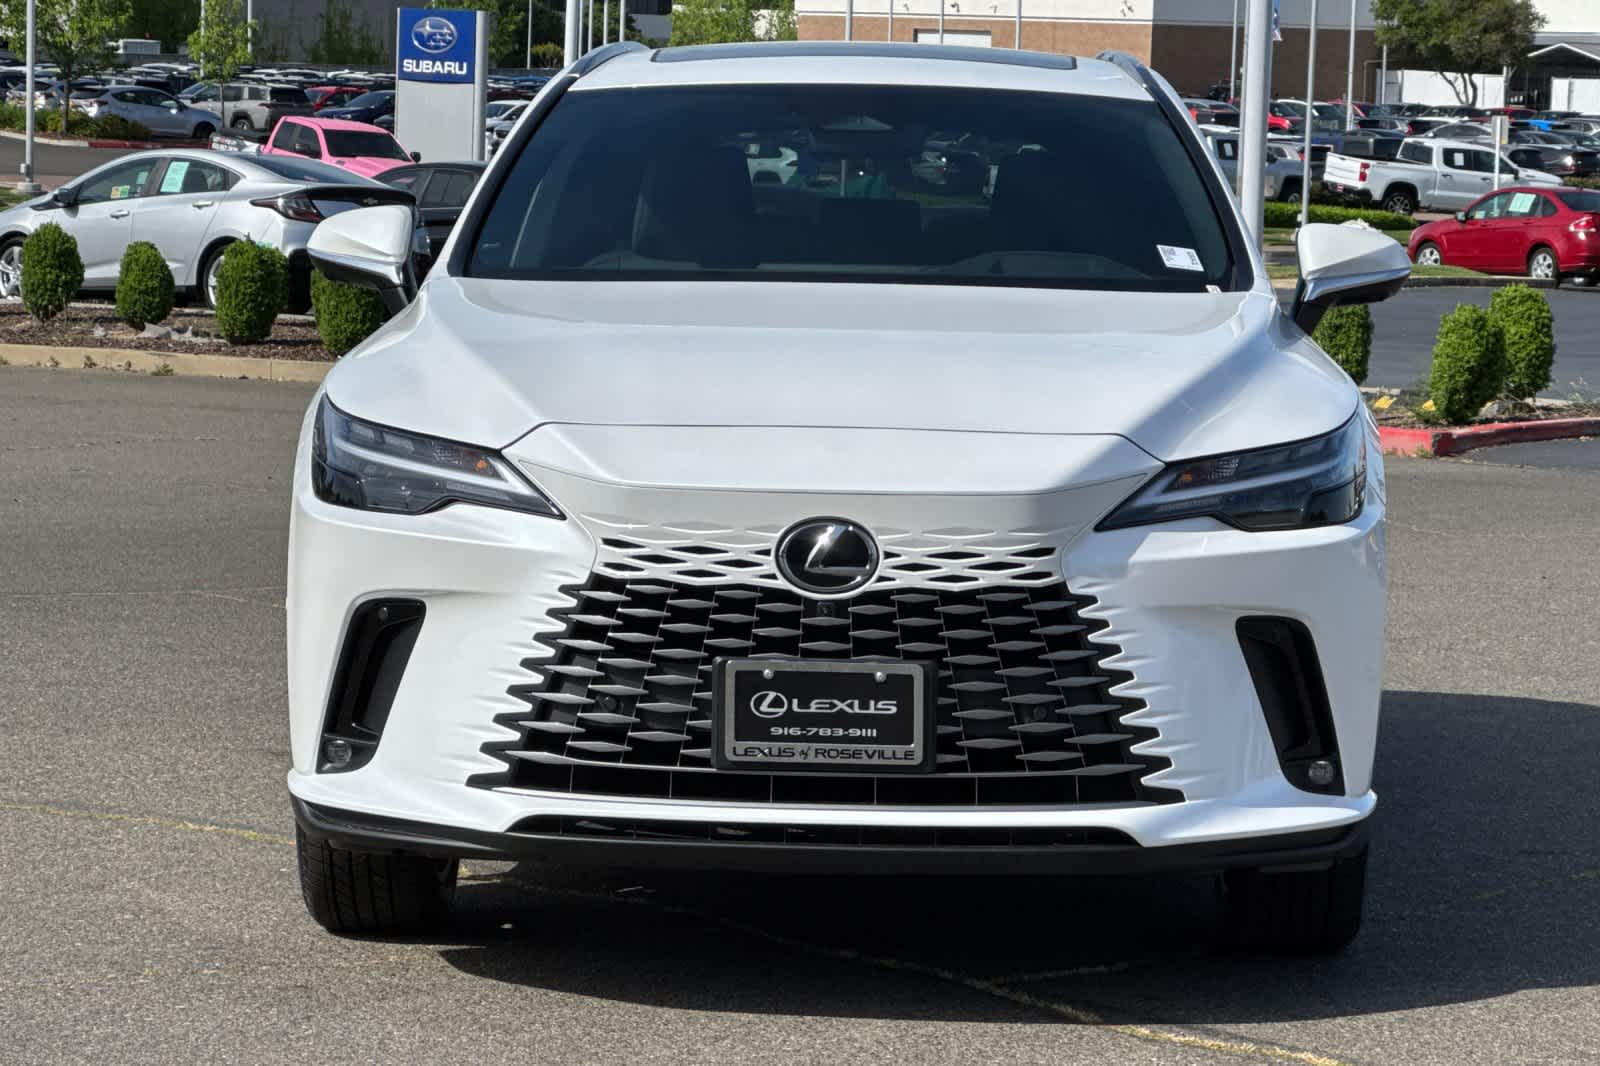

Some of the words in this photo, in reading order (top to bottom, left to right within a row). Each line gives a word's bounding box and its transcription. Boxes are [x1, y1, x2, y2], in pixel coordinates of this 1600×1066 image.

[403, 59, 467, 75] SUBARU
[792, 698, 898, 714] LEXUS
[770, 726, 877, 738] 916-783-9111
[733, 746, 796, 758] LEXUS
[815, 748, 915, 761] ROSEVILLE
